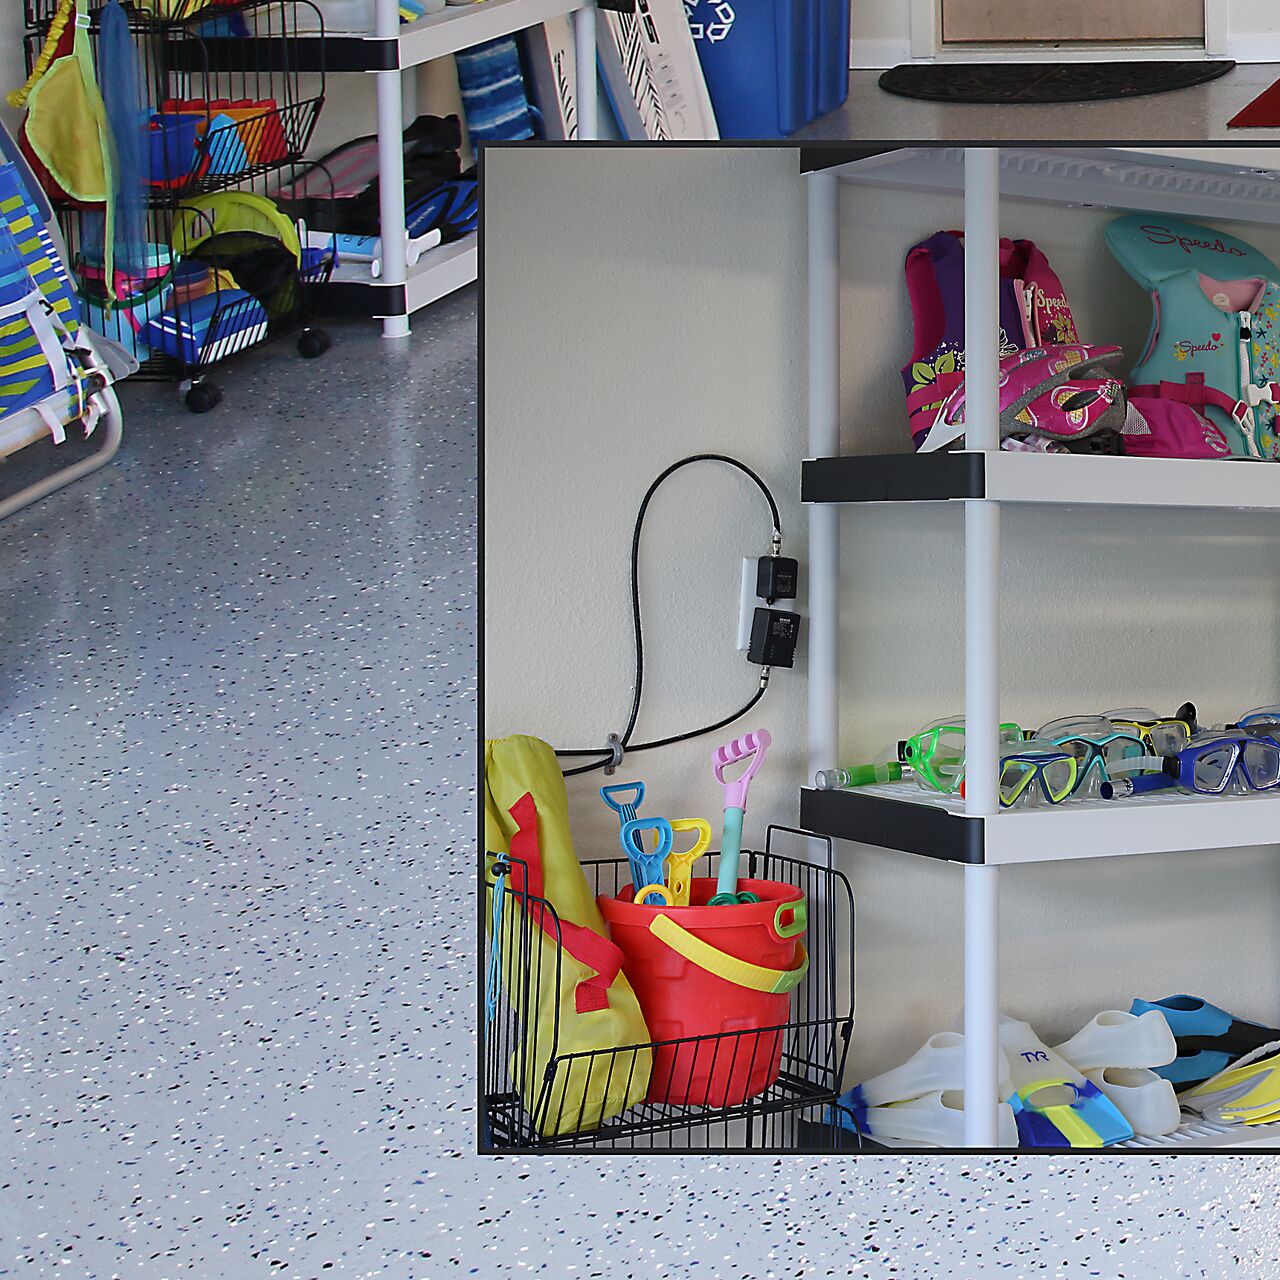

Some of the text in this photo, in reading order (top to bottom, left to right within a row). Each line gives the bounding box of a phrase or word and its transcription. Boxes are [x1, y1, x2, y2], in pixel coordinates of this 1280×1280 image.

[1140, 225, 1247, 257] Speedo
[1179, 340, 1219, 358] Speedo
[1020, 1051, 1050, 1063] TYR
